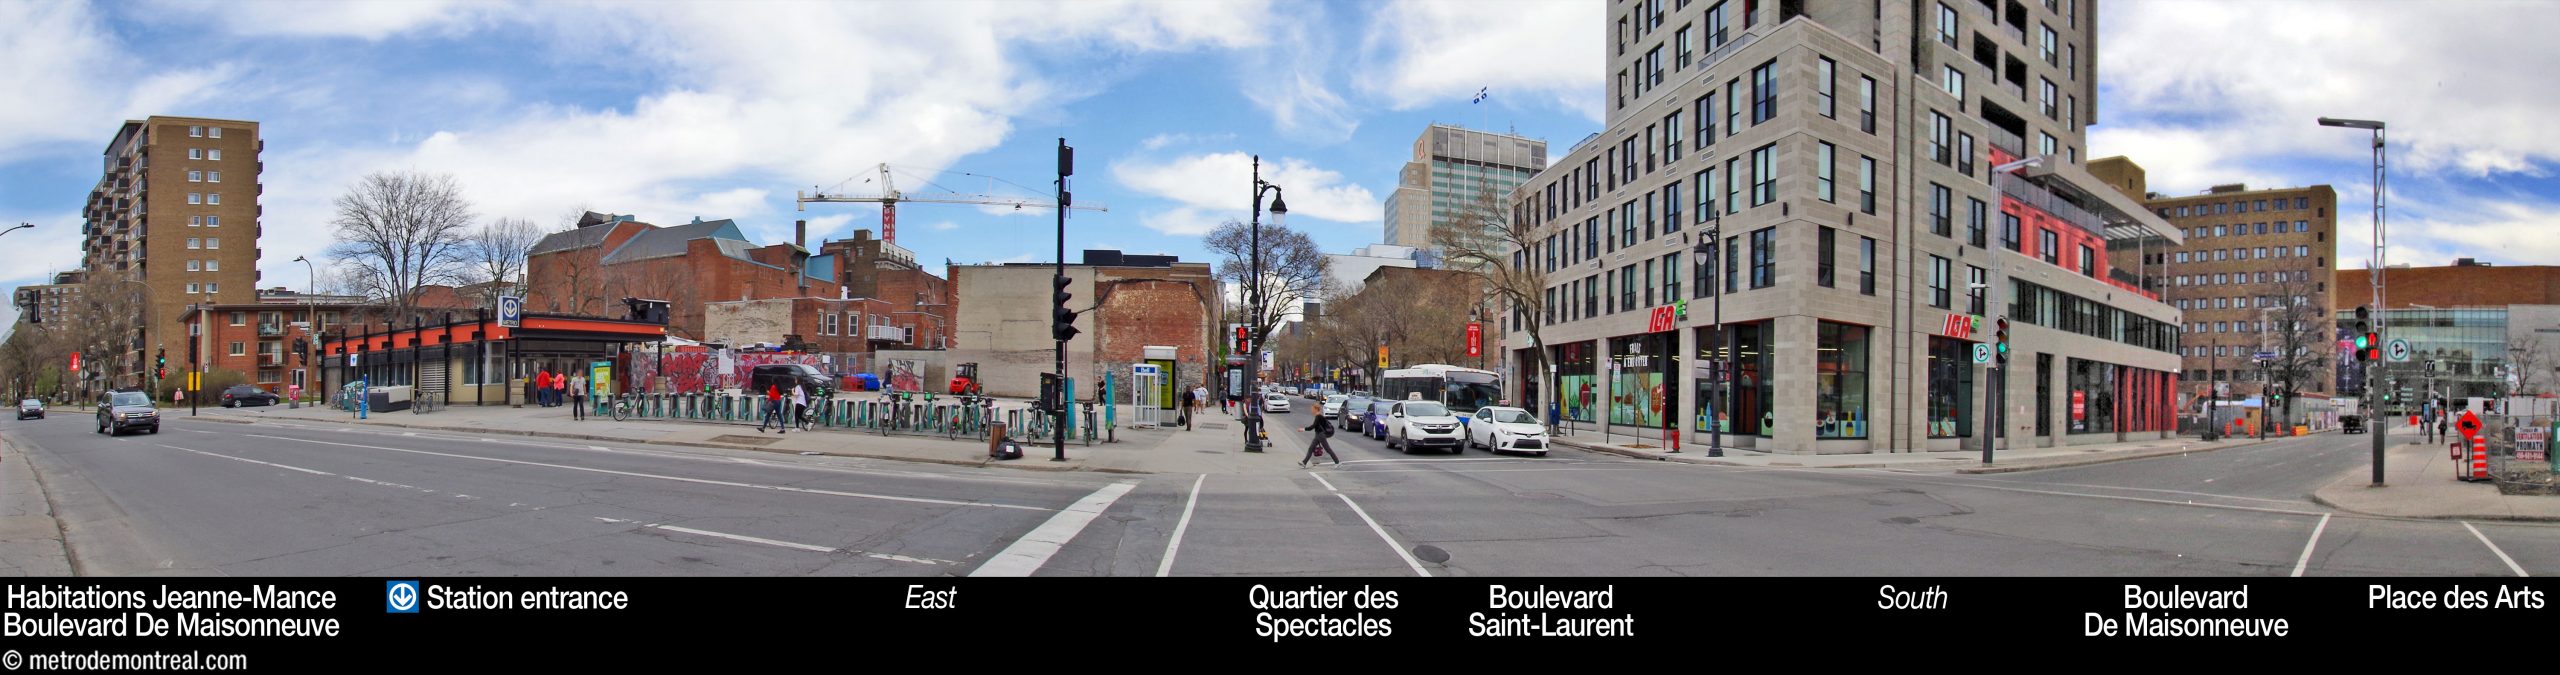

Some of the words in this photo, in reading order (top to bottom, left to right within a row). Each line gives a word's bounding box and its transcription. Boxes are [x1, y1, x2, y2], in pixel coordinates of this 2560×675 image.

[1648, 304, 1676, 333] IGA
[1942, 313, 1971, 339] IGA
[2516, 441, 2543, 450] PROMATH
